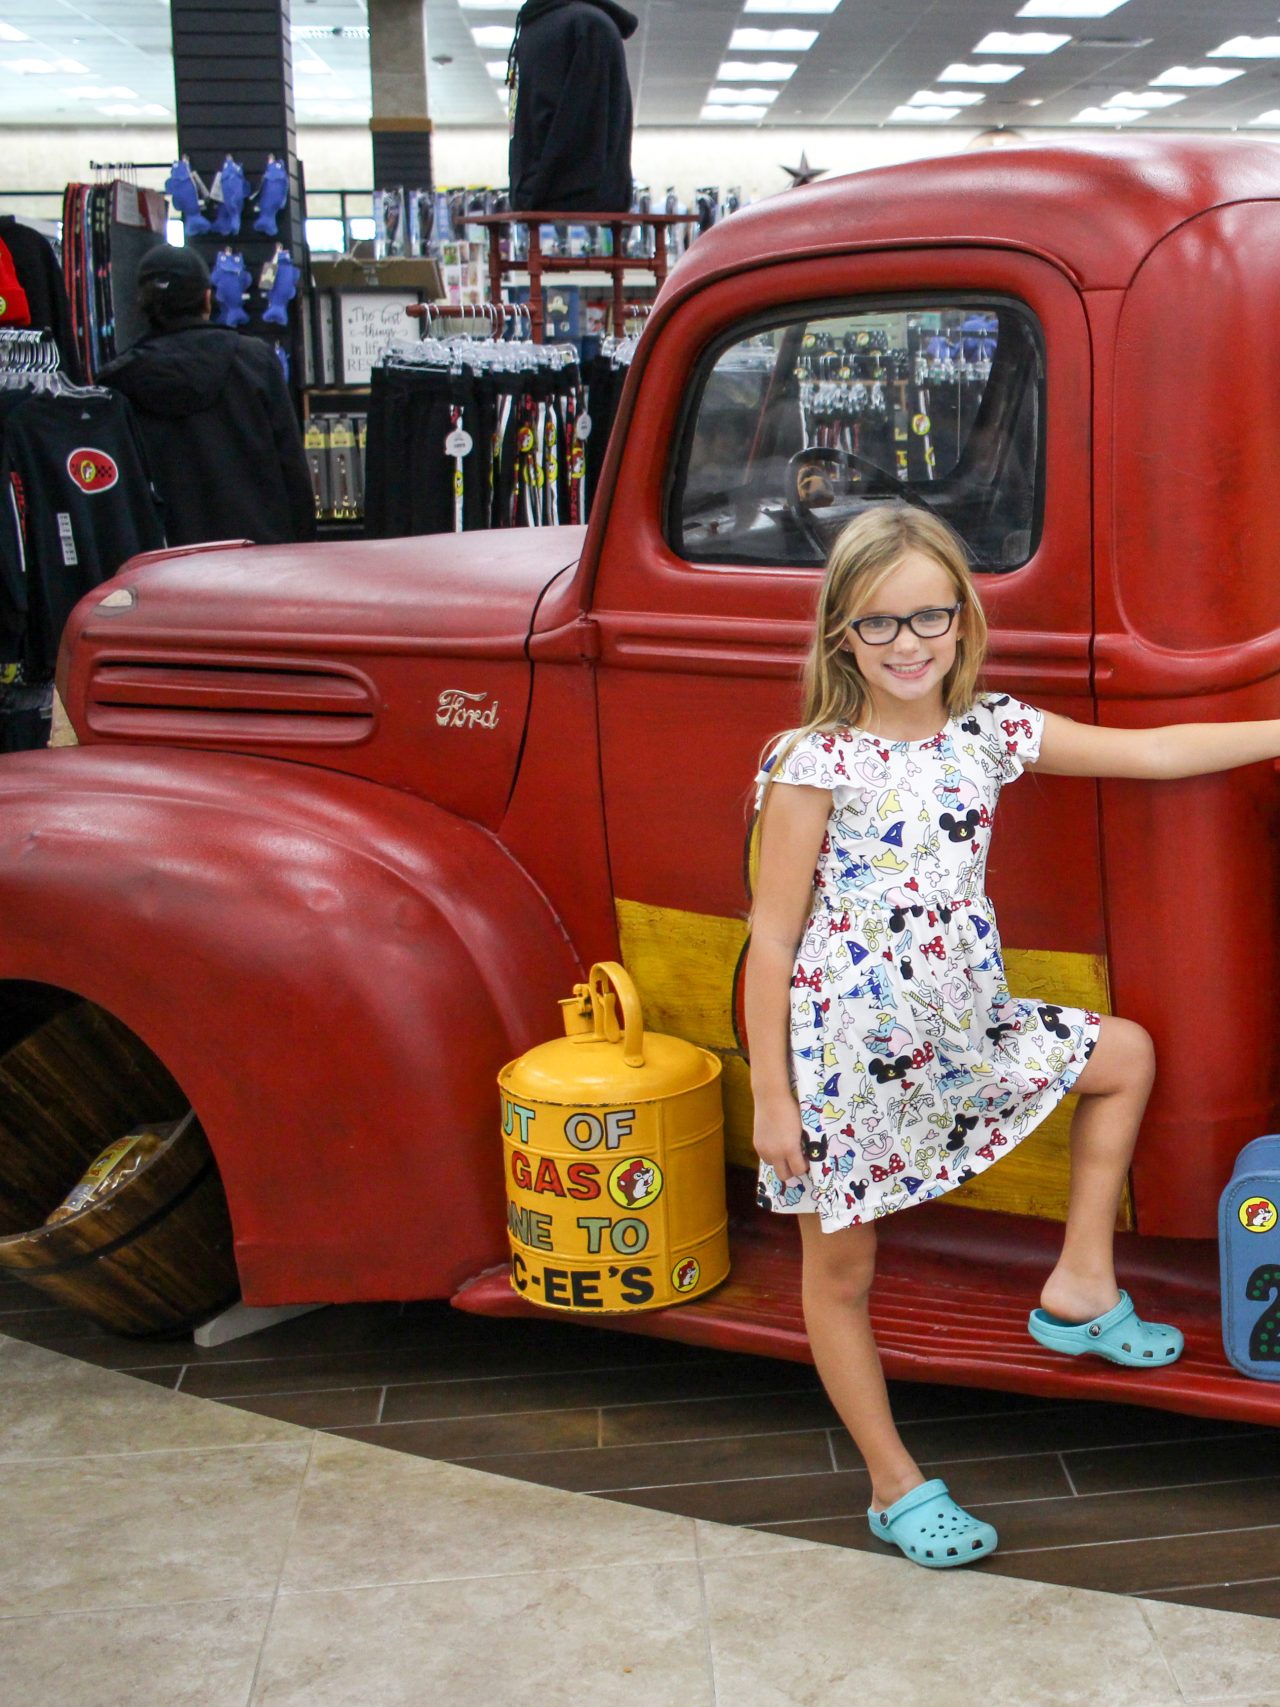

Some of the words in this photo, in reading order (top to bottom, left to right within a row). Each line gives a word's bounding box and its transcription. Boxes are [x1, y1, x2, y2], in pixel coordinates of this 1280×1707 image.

[361, 324, 396, 342] things
[365, 341, 380, 355] lif
[435, 689, 500, 729] Ford
[501, 1098, 536, 1144] UT
[564, 1109, 636, 1151] OF
[512, 1151, 602, 1200] GAS
[508, 1200, 554, 1251] NE
[577, 1217, 650, 1255] TO
[512, 1252, 655, 1308] C-EE'S
